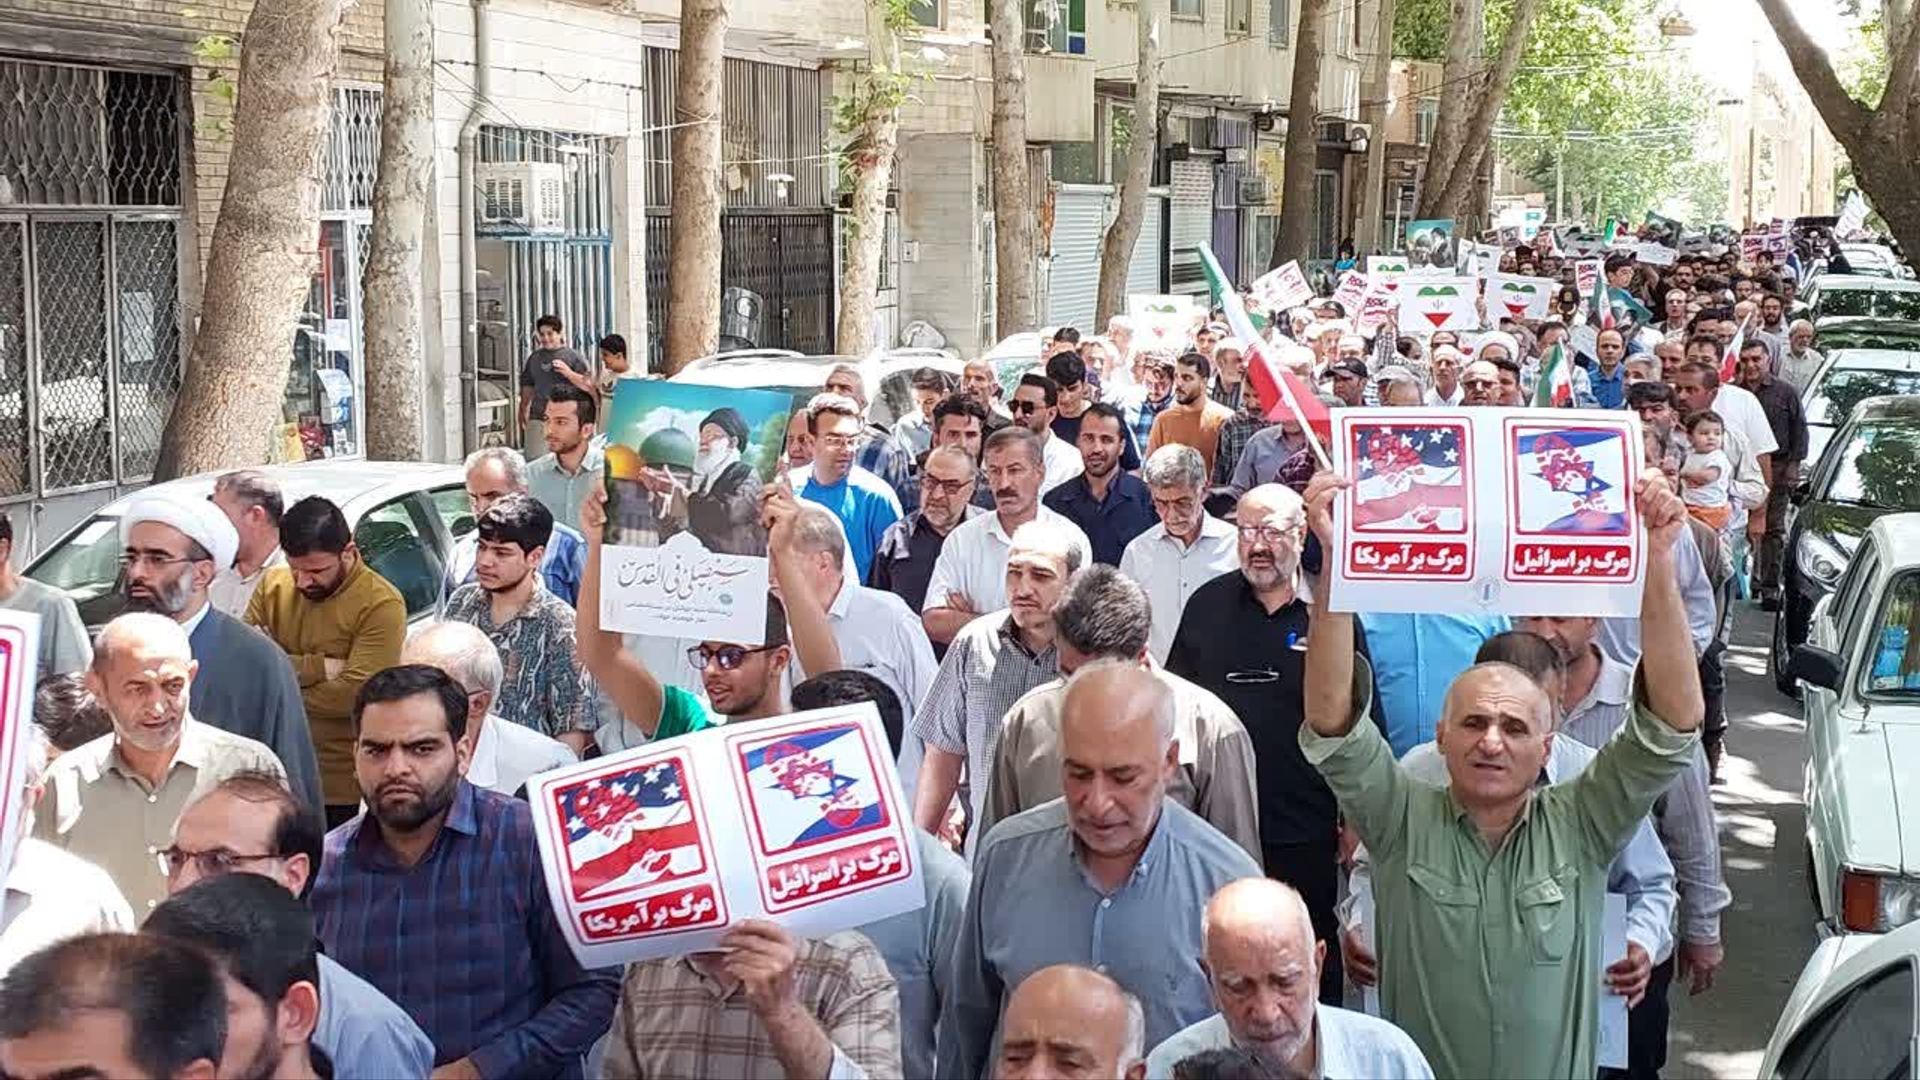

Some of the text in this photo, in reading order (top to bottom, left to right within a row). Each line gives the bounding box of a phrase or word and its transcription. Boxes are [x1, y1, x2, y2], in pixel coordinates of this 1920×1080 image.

[1355, 544, 1464, 571] مرگ بر آمریکا
[1515, 547, 1630, 574] مرگ بر اسرائیل
[772, 844, 900, 900] مرگ بر اسرائیل
[584, 892, 713, 933] مرگ بر آمریکا
